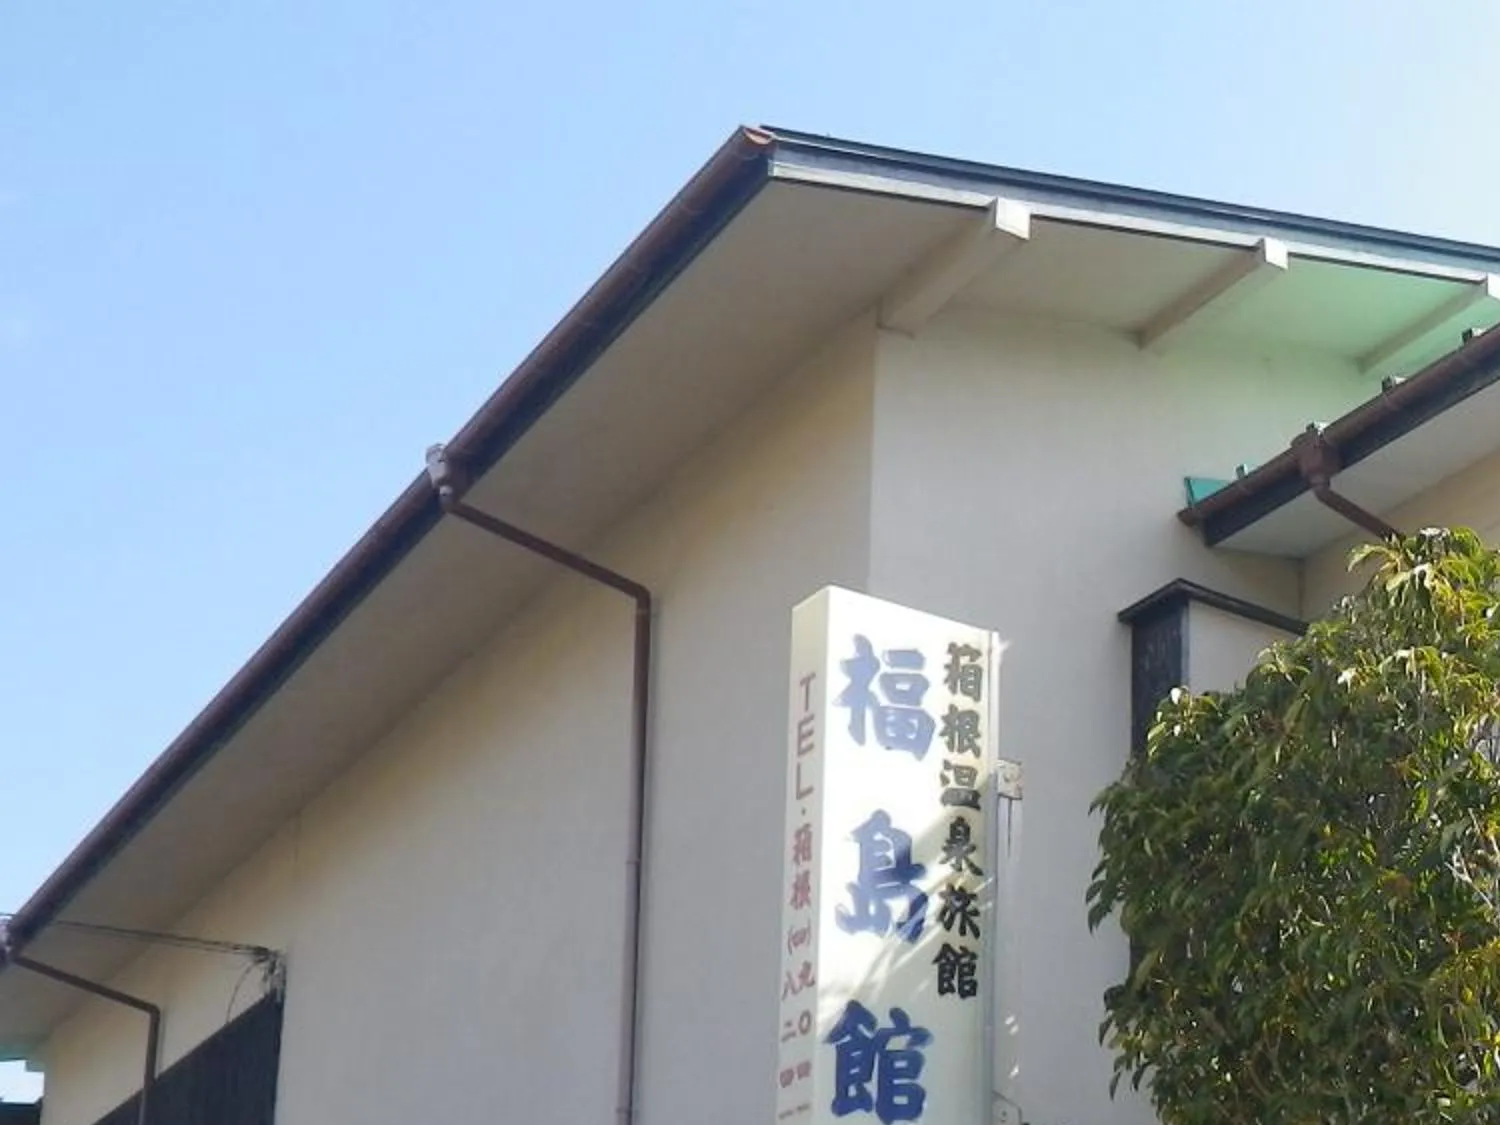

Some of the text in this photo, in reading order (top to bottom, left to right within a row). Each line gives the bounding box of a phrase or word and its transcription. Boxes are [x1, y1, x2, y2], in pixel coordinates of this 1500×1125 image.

[932, 642, 983, 1000] 箱根温泉旅館
